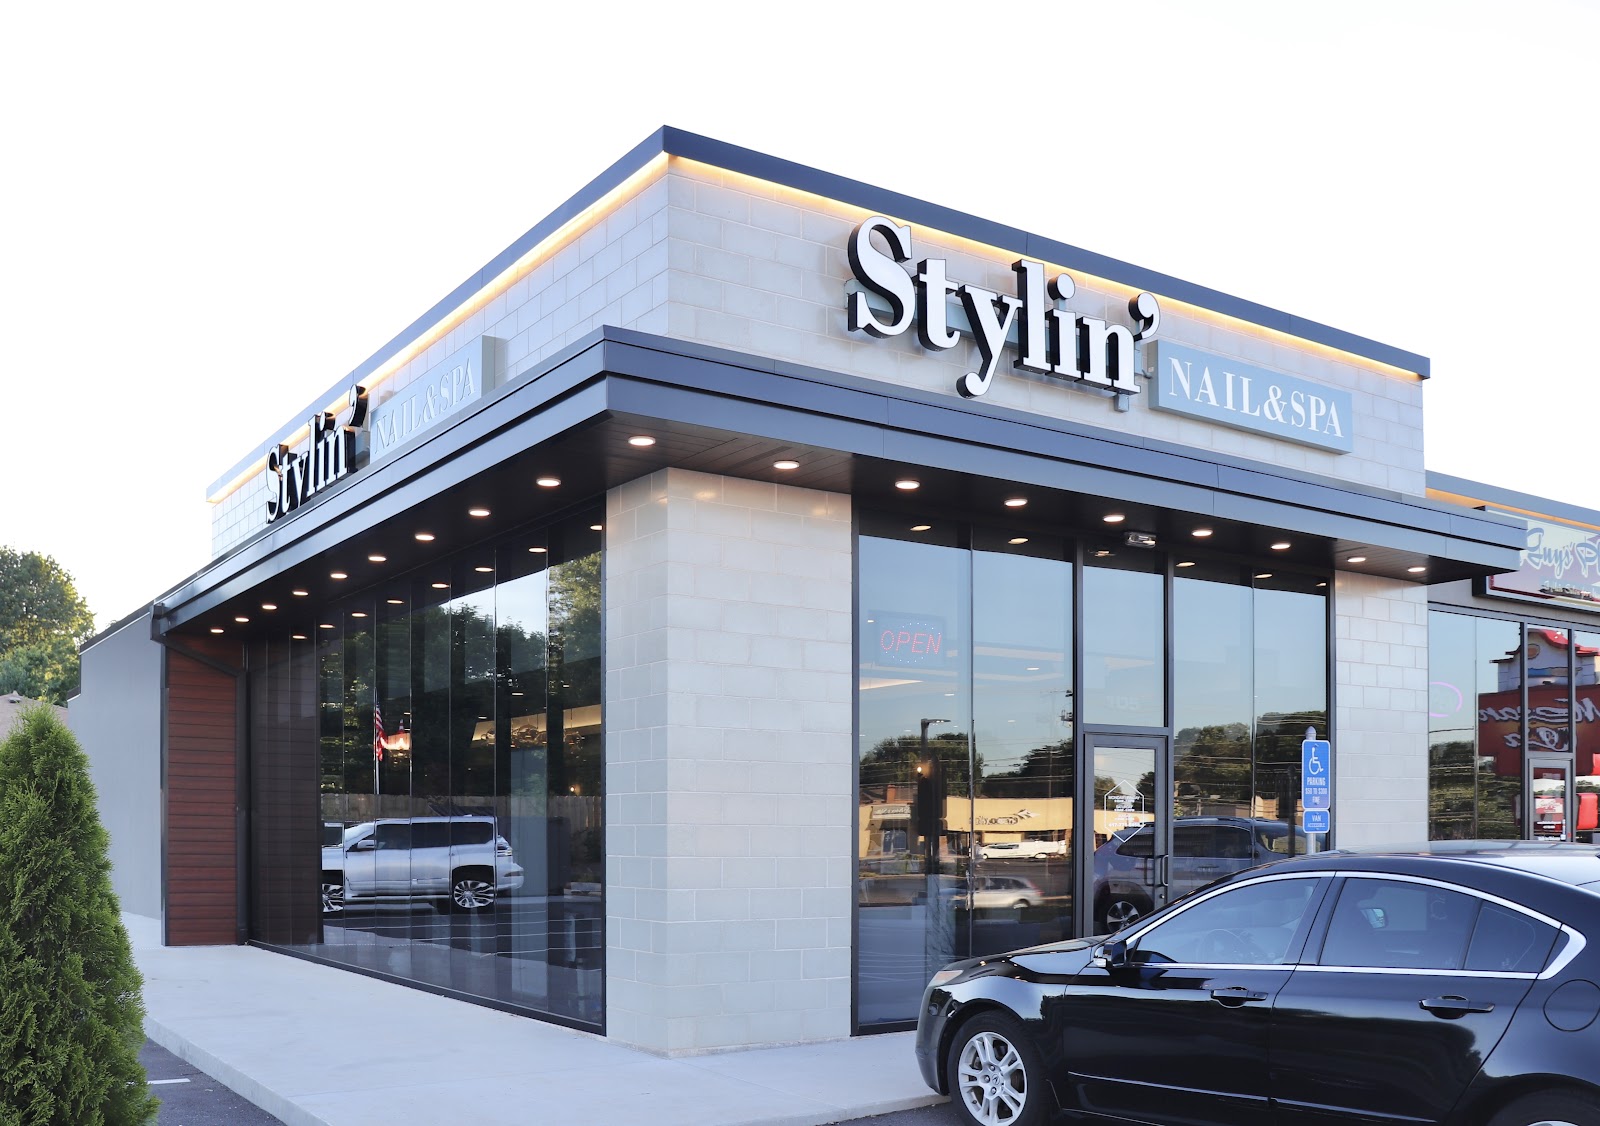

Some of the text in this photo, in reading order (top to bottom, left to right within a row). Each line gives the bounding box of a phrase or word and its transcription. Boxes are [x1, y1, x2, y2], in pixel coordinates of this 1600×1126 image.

[848, 216, 1160, 398] Stylin'
[880, 630, 943, 655] OPEN
[1306, 777, 1326, 786] PARKING
